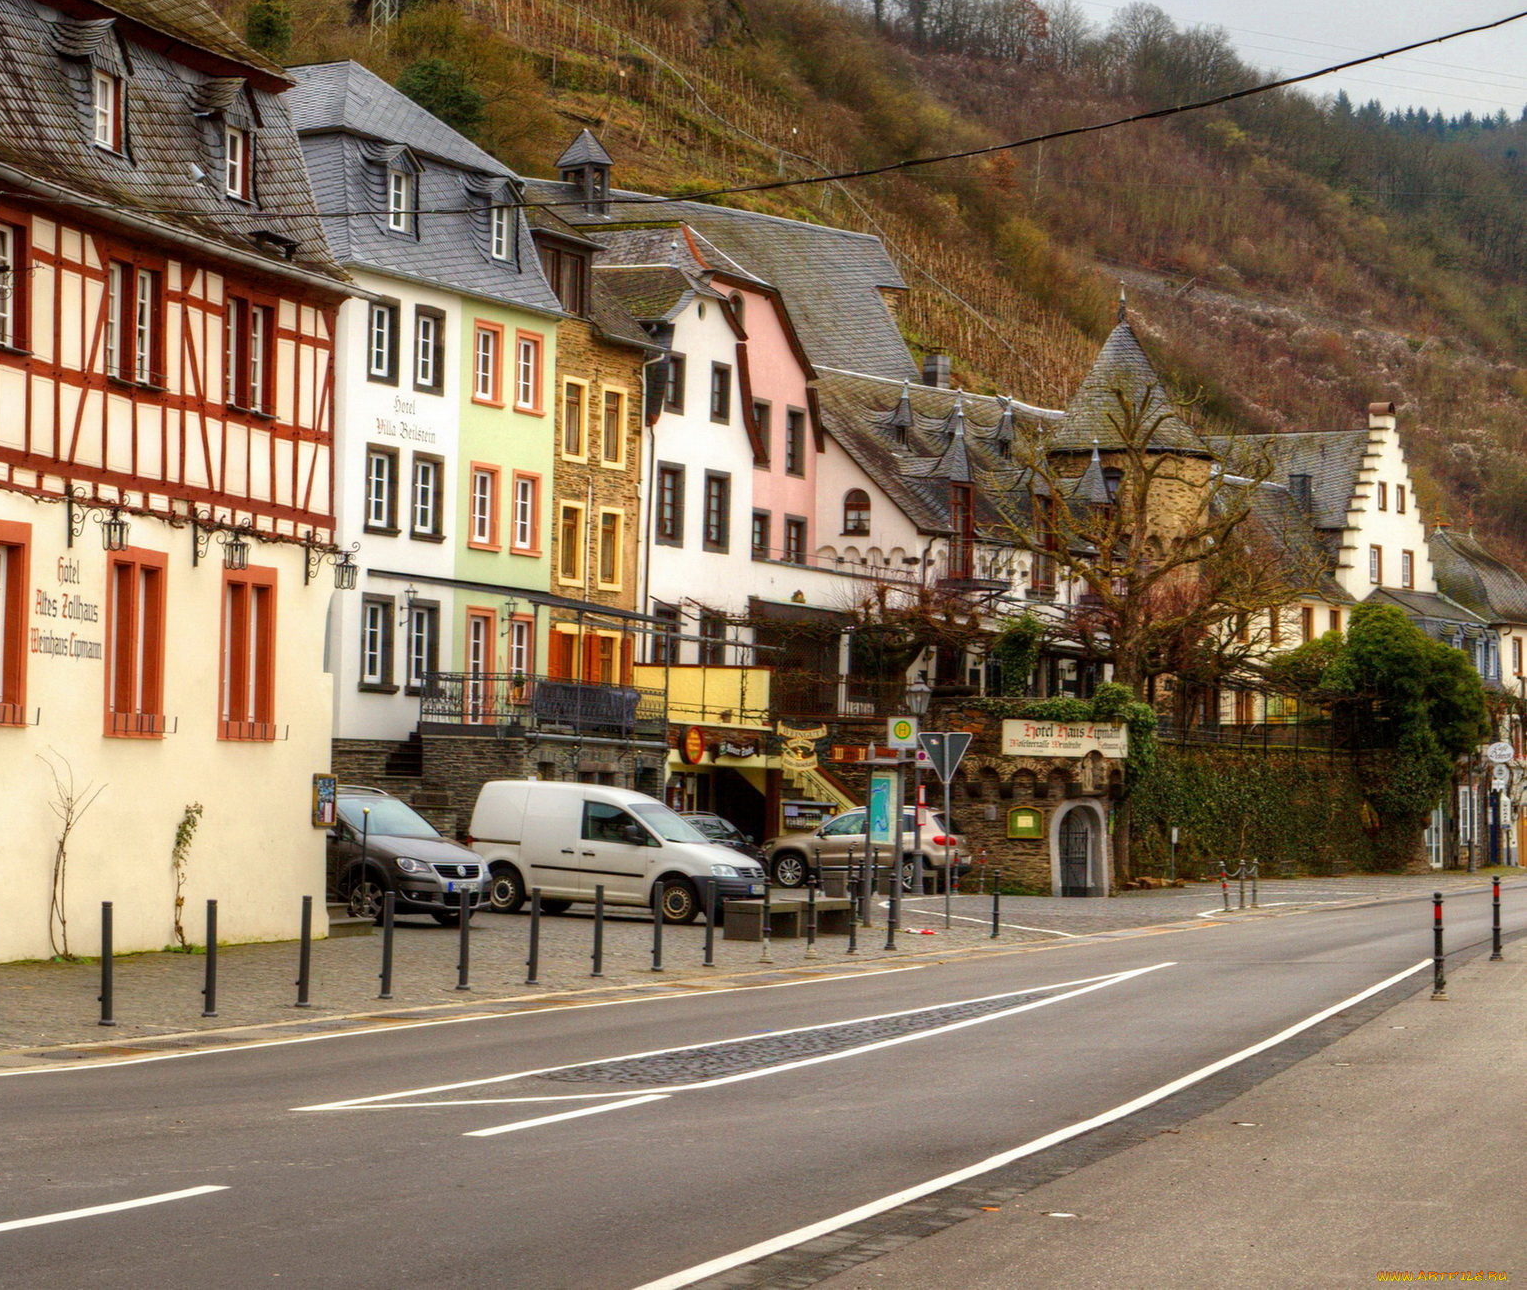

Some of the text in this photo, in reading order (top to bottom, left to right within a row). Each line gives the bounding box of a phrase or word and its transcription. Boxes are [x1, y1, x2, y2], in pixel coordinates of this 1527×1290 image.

[393, 395, 416, 415] Hotel
[376, 417, 436, 444] Villa Beilstein
[57, 556, 80, 587] Hotel
[35, 589, 98, 624] Altes Zollhaus
[31, 627, 103, 662] Weinhaus Lipmann
[1023, 722, 1054, 740] Hotel
[1054, 722, 1085, 741] Haus
